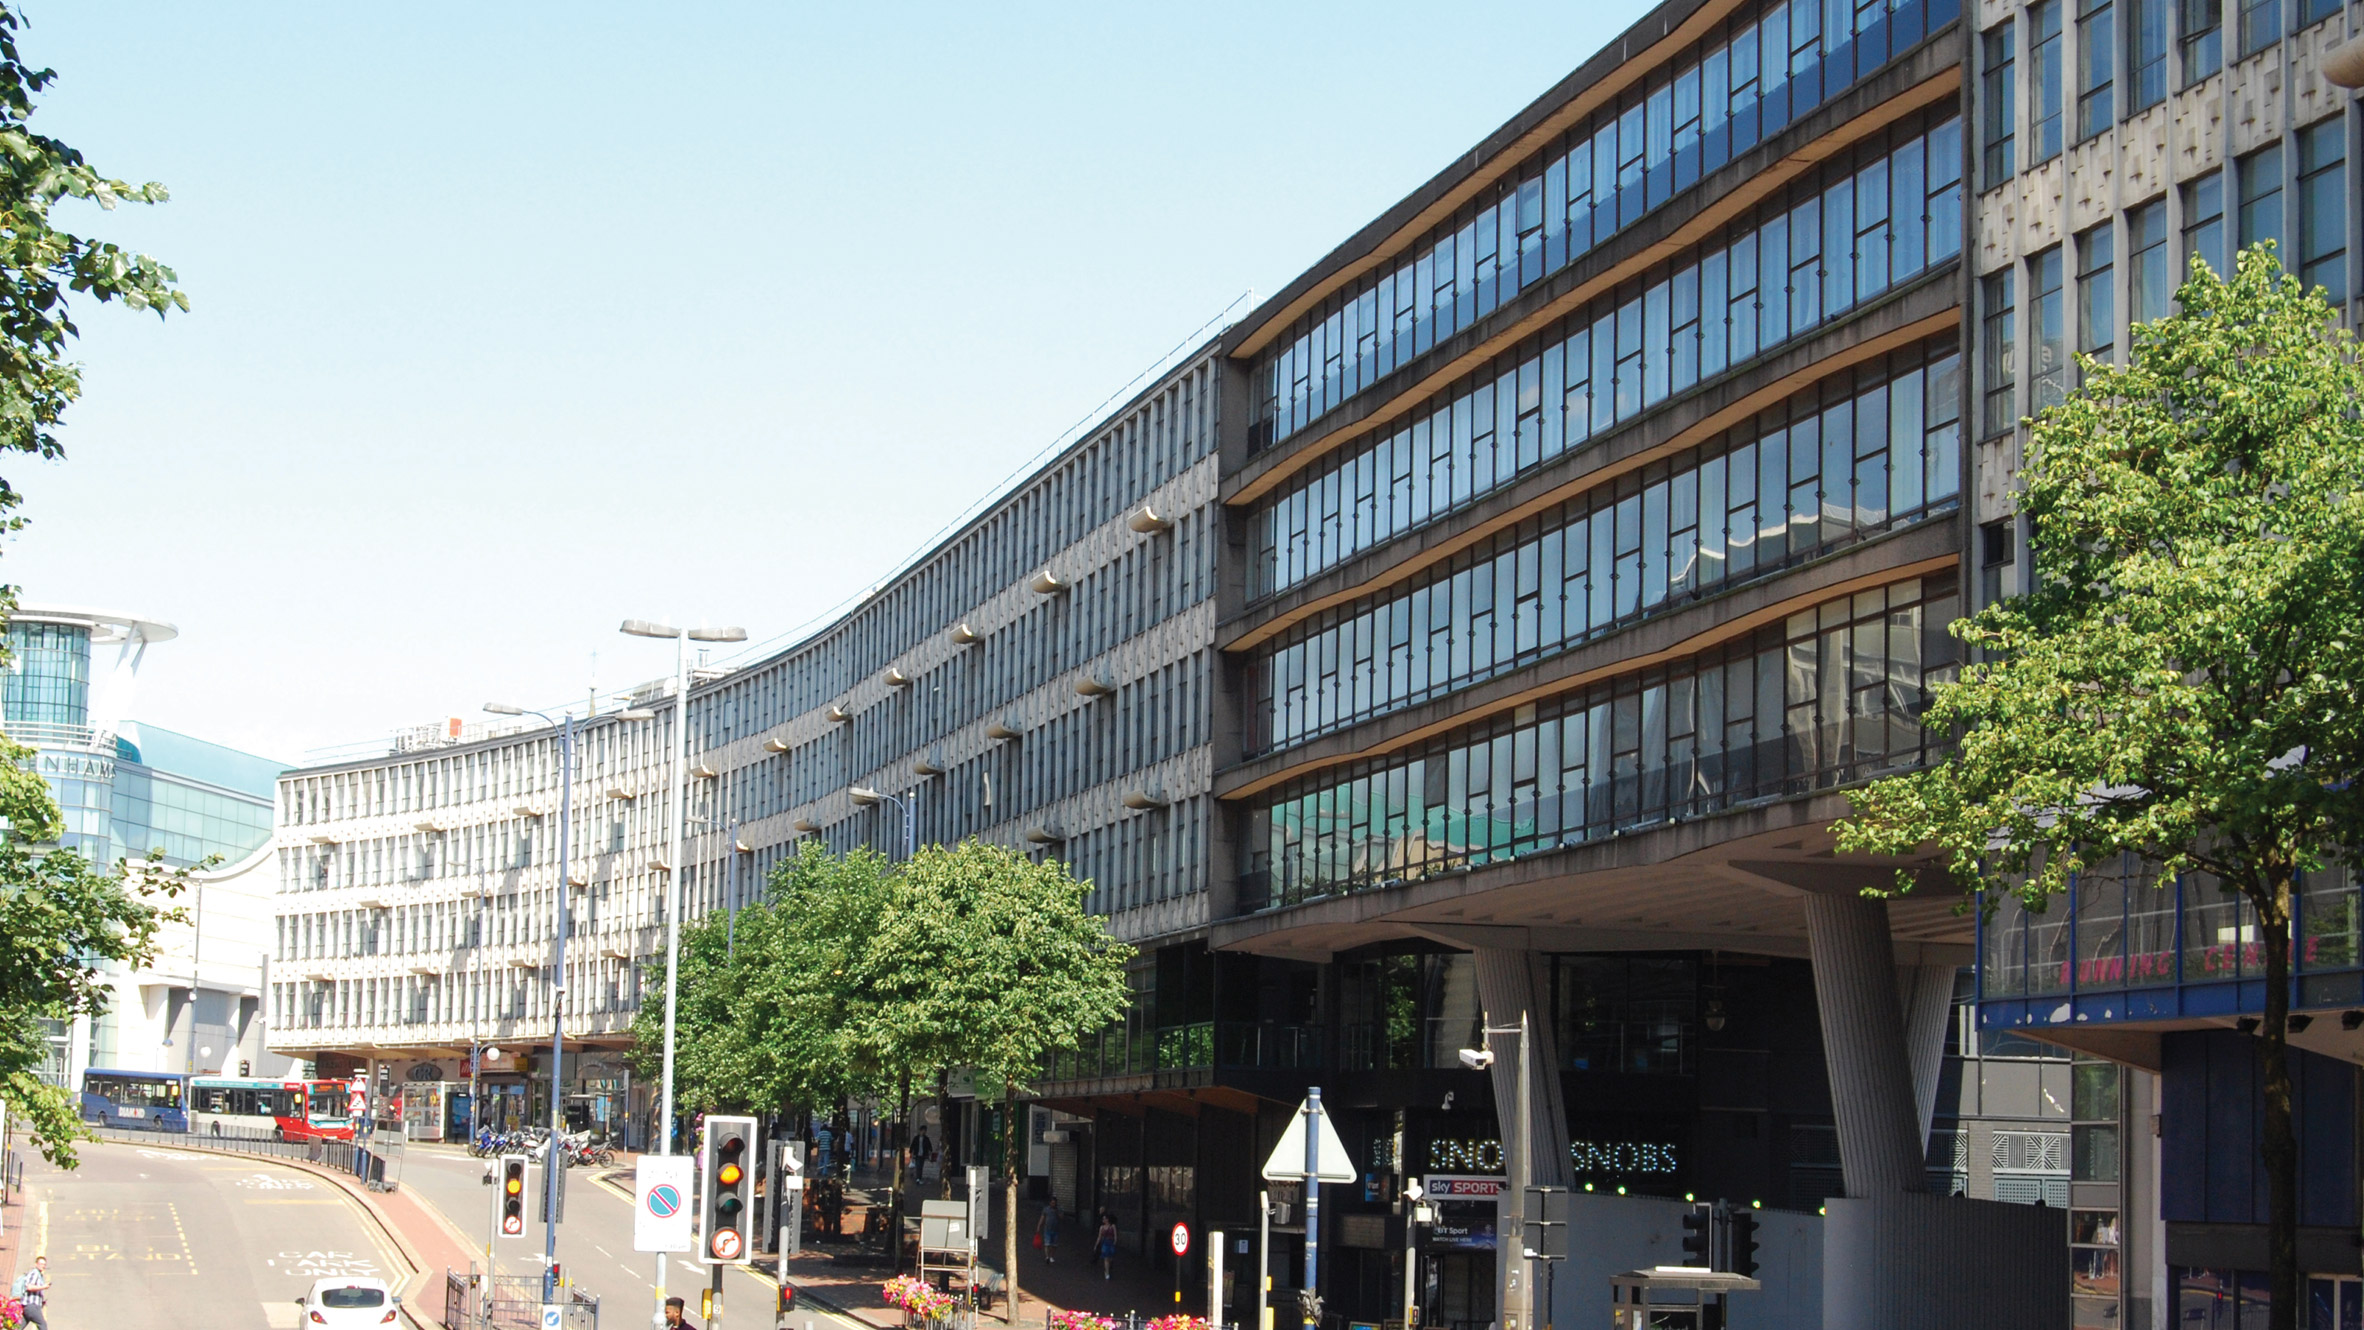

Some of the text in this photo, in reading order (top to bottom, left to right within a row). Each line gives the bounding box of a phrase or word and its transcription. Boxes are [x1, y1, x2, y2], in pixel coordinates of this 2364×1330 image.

[2059, 936, 2320, 985] RUNNING CENE
[1430, 1138, 1505, 1171] SNO
[1569, 1140, 1677, 1173] SNOBS
[1432, 1181, 1451, 1194] sky
[1449, 1227, 1468, 1236] Sport
[1175, 1233, 1186, 1245] 30
[278, 1251, 353, 1259] CAR
[285, 1268, 381, 1277] ONLY
